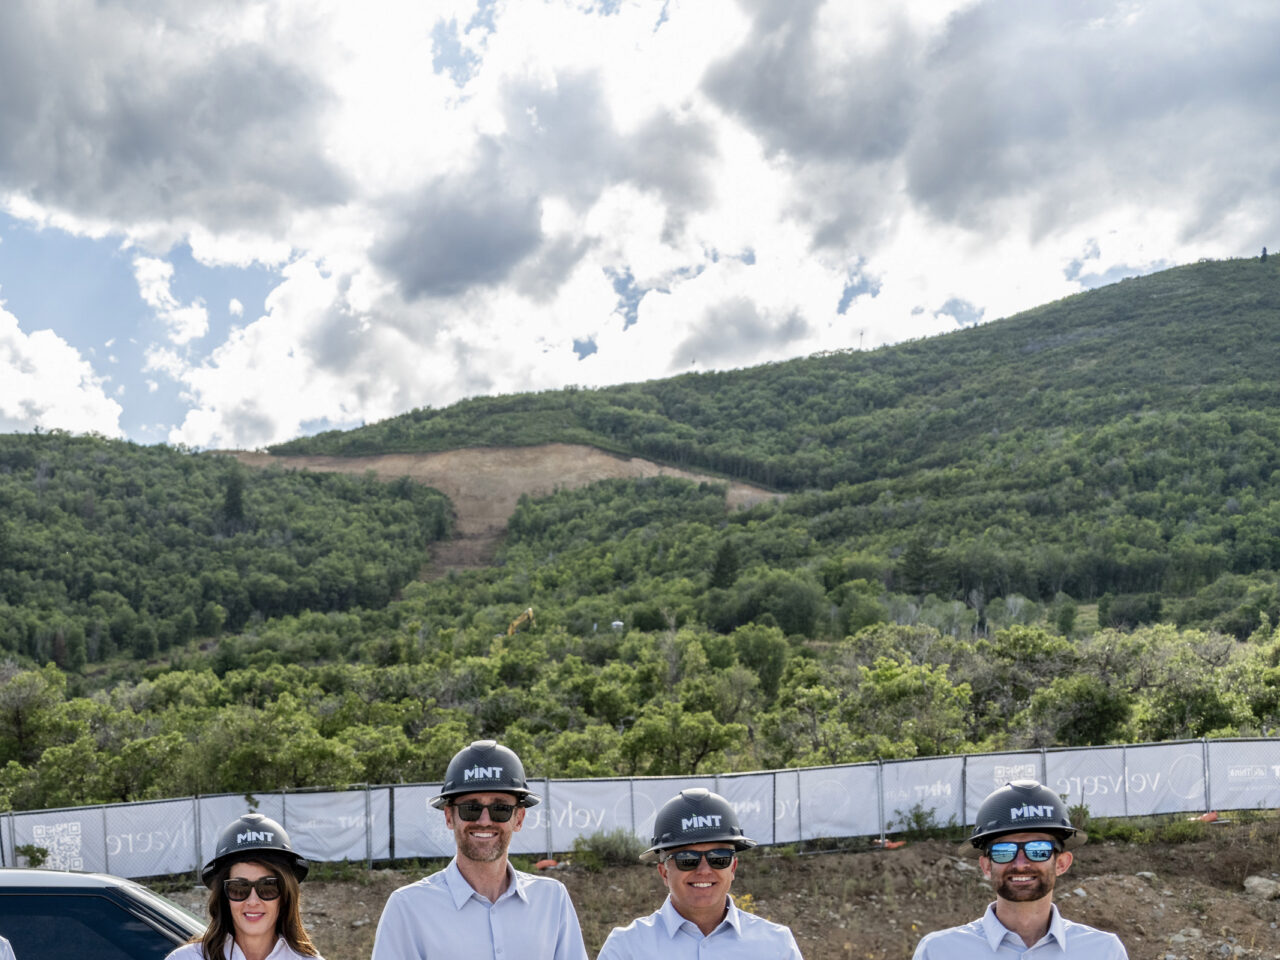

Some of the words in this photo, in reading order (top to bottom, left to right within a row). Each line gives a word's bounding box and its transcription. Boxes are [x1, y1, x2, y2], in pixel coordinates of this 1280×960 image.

[464, 764, 503, 781] MINT
[1010, 803, 1054, 820] MINT
[681, 813, 722, 830] MINT
[236, 828, 274, 844] MINT
